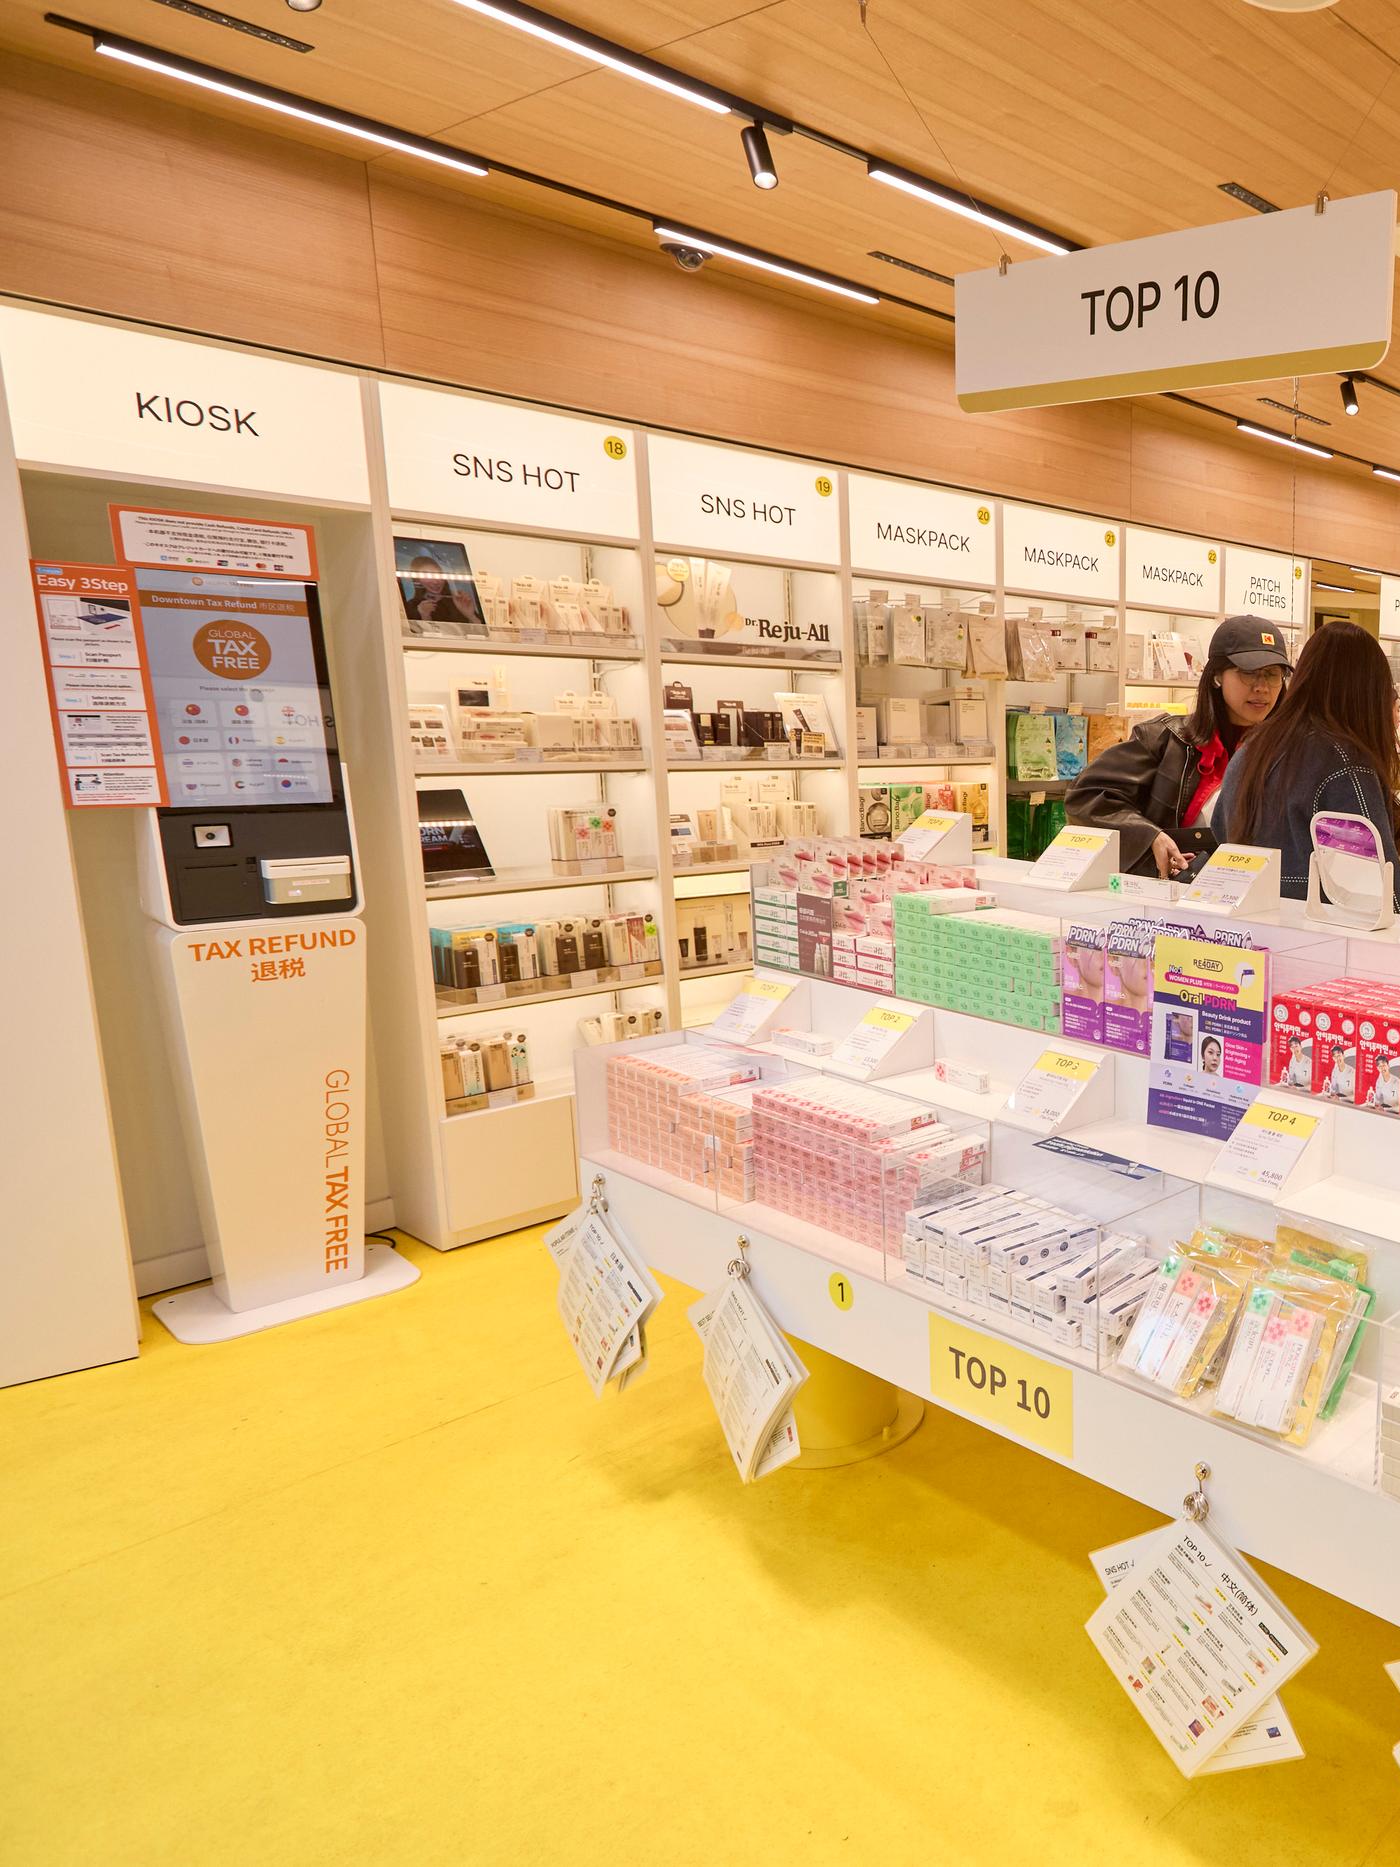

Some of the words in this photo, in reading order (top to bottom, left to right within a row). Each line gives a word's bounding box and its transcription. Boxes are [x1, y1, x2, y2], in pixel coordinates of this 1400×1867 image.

[1081, 282, 1163, 337] TOP
[1172, 269, 1221, 322] 10
[135, 391, 260, 437] KIOSK
[606, 440, 624, 456] 18
[452, 453, 514, 483] SNS
[522, 463, 580, 493] HOT
[818, 480, 831, 494] 19
[700, 493, 747, 519] SNS
[752, 501, 796, 526] HOT
[978, 509, 990, 522] 20
[876, 522, 970, 553] MASKPACK
[1105, 532, 1115, 546] 21
[1023, 546, 1099, 573] MASKPACK
[1208, 552, 1217, 562] 22
[36, 574, 76, 590] Easy
[81, 577, 129, 594] 3Step
[1142, 564, 1204, 588] MASKPACK
[1250, 576, 1281, 593] PATCH
[151, 595, 205, 607] Downtown
[206, 598, 223, 608] Tax
[224, 599, 258, 610] Refund
[1249, 591, 1287, 609] OTHERS
[208, 629, 256, 640] GLOBAL
[745, 618, 758, 627] Dr.
[758, 619, 831, 643] Reju-All
[207, 639, 259, 656] TAX
[212, 655, 260, 670] FREE
[419, 826, 446, 837] DRN
[420, 835, 448, 843] REAM
[1071, 835, 1086, 843] TOP
[1228, 854, 1244, 863] TOP
[1068, 926, 1097, 944] PDRN
[1111, 935, 1140, 951] PDRN
[1215, 931, 1243, 948] PDRN
[188, 938, 242, 962] TAX
[248, 929, 357, 956] REFUND
[251, 957, 306, 984] 退税
[1169, 974, 1189, 985] WOMEN
[1189, 977, 1203, 987] PLUS
[1180, 990, 1203, 1005] Oral
[1203, 994, 1237, 1011] PDRN
[1202, 1011, 1217, 1021] Beauty
[1218, 1014, 1232, 1022] Drink
[1233, 1016, 1251, 1026] product
[1055, 1057, 1073, 1068] TOP
[325, 1068, 350, 1168] GLOBAL
[1268, 1110, 1289, 1123] TOP
[1289, 1117, 1297, 1125] 4
[325, 1166, 350, 1214] TAX
[325, 1213, 349, 1275] FREE
[837, 1282, 845, 1302] 1
[948, 1345, 1007, 1397] TOP
[1016, 1379, 1051, 1419] 10
[1183, 1535, 1198, 1553] TOP
[1197, 1551, 1207, 1562] 10
[1104, 1565, 1117, 1576] SNS
[1117, 1561, 1130, 1573] HOT
[1220, 1573, 1259, 1617] 中文(简体)
